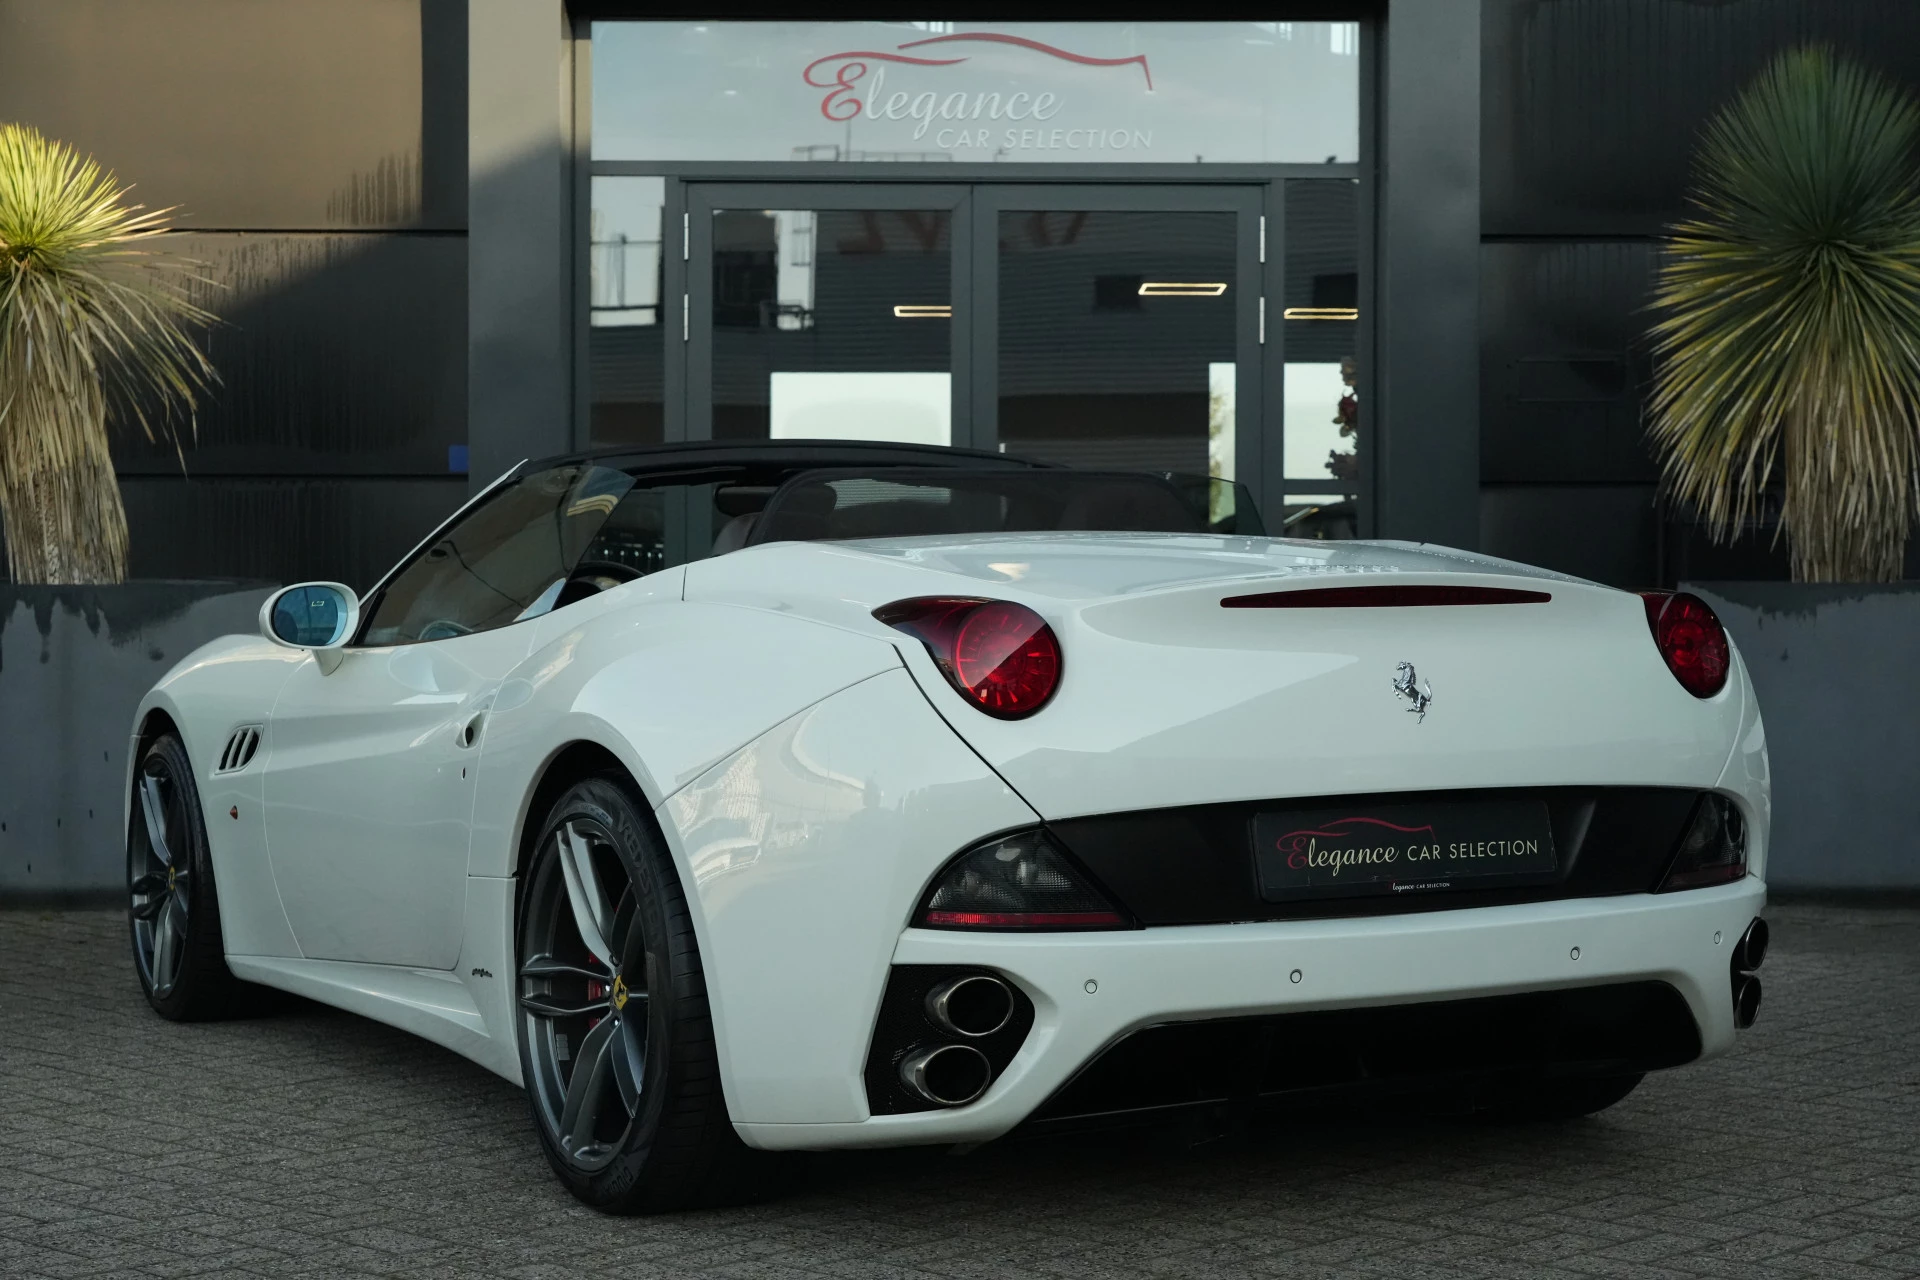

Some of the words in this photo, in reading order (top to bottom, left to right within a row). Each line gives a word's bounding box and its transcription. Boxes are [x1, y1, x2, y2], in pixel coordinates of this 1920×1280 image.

[803, 51, 1063, 140] Elegance
[935, 128, 990, 149] CAR
[1003, 128, 1153, 149] SELECTION
[1277, 830, 1400, 877] Elegance
[1407, 844, 1441, 861] CAR
[1449, 839, 1538, 859] SELECTION
